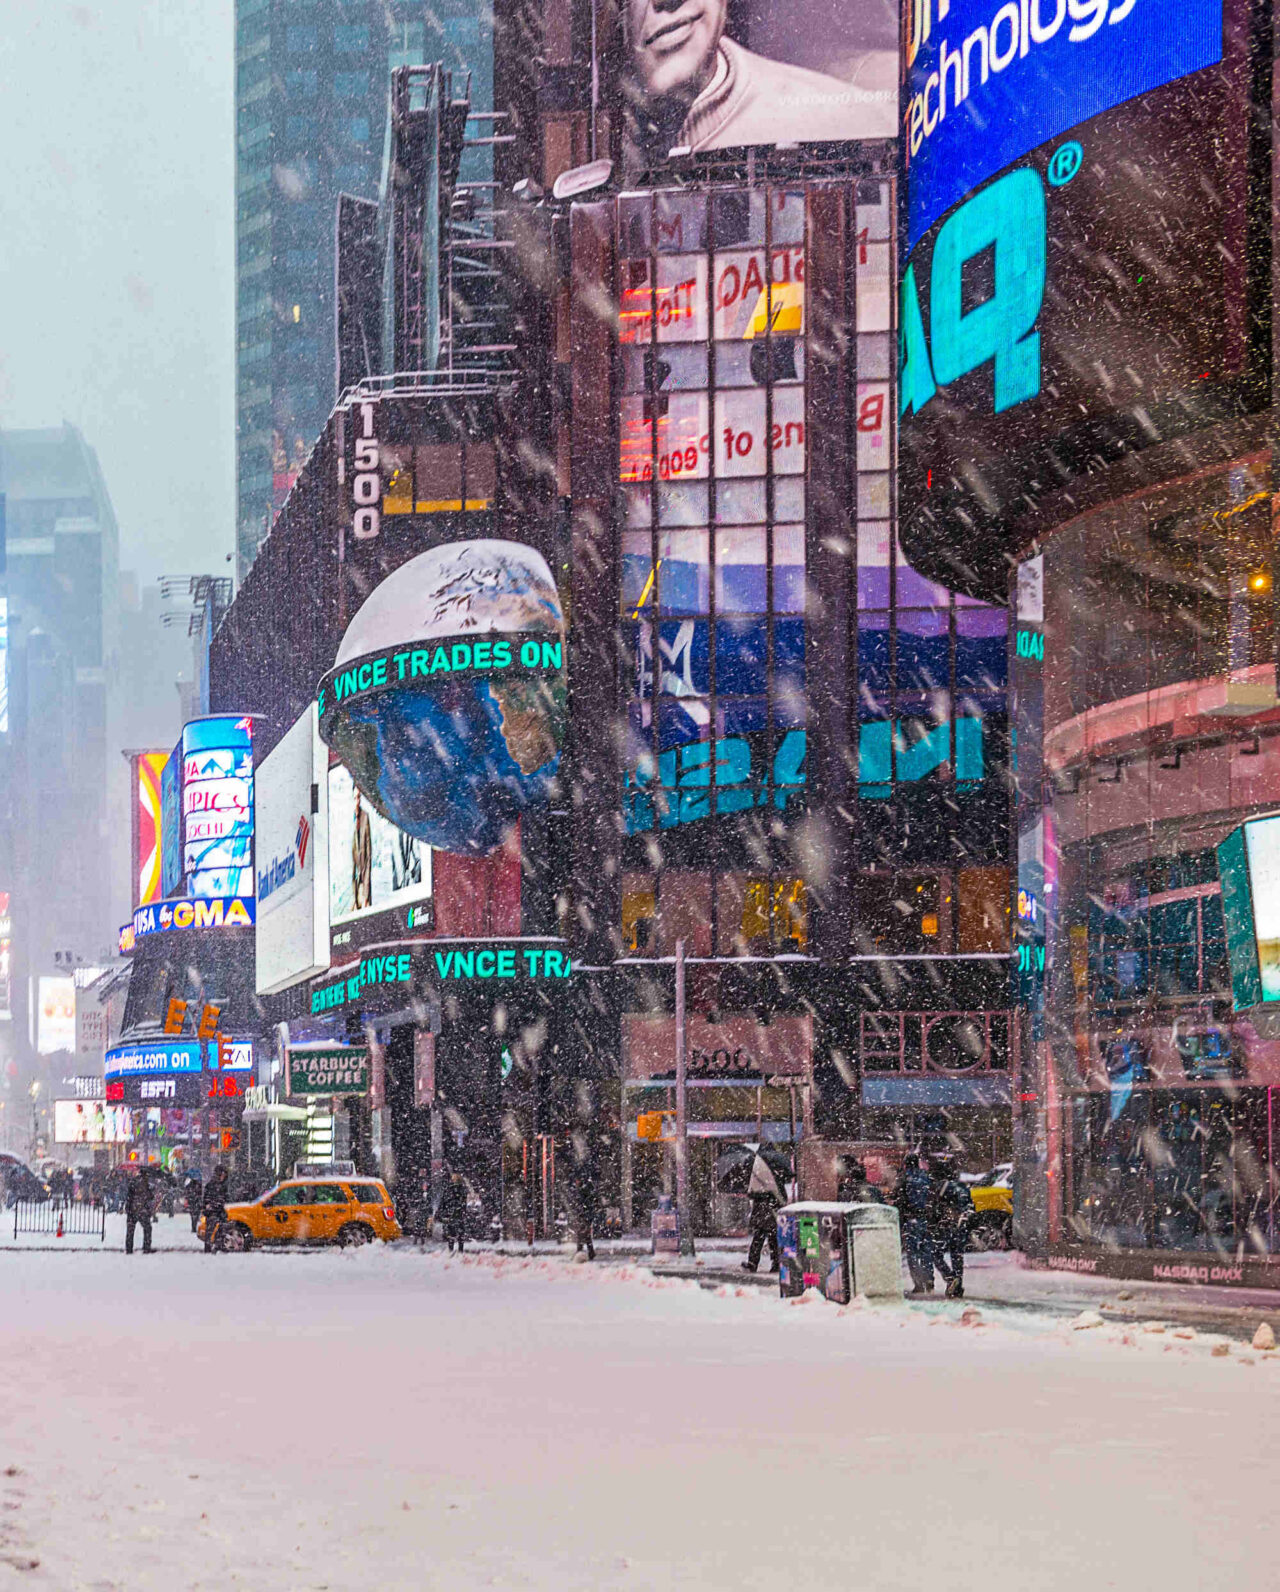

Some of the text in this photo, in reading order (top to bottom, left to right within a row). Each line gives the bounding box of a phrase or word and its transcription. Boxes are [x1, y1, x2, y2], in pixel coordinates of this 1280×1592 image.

[352, 402, 381, 539] 1500
[333, 640, 562, 702] VNCE TRADES ON
[174, 899, 252, 928] GMA
[435, 950, 517, 980] VNCE
[171, 1052, 190, 1068] on
[141, 1080, 176, 1099] ESPN
[308, 1070, 362, 1086] COFFEE
[1153, 1264, 1208, 1283] NASDAQ
